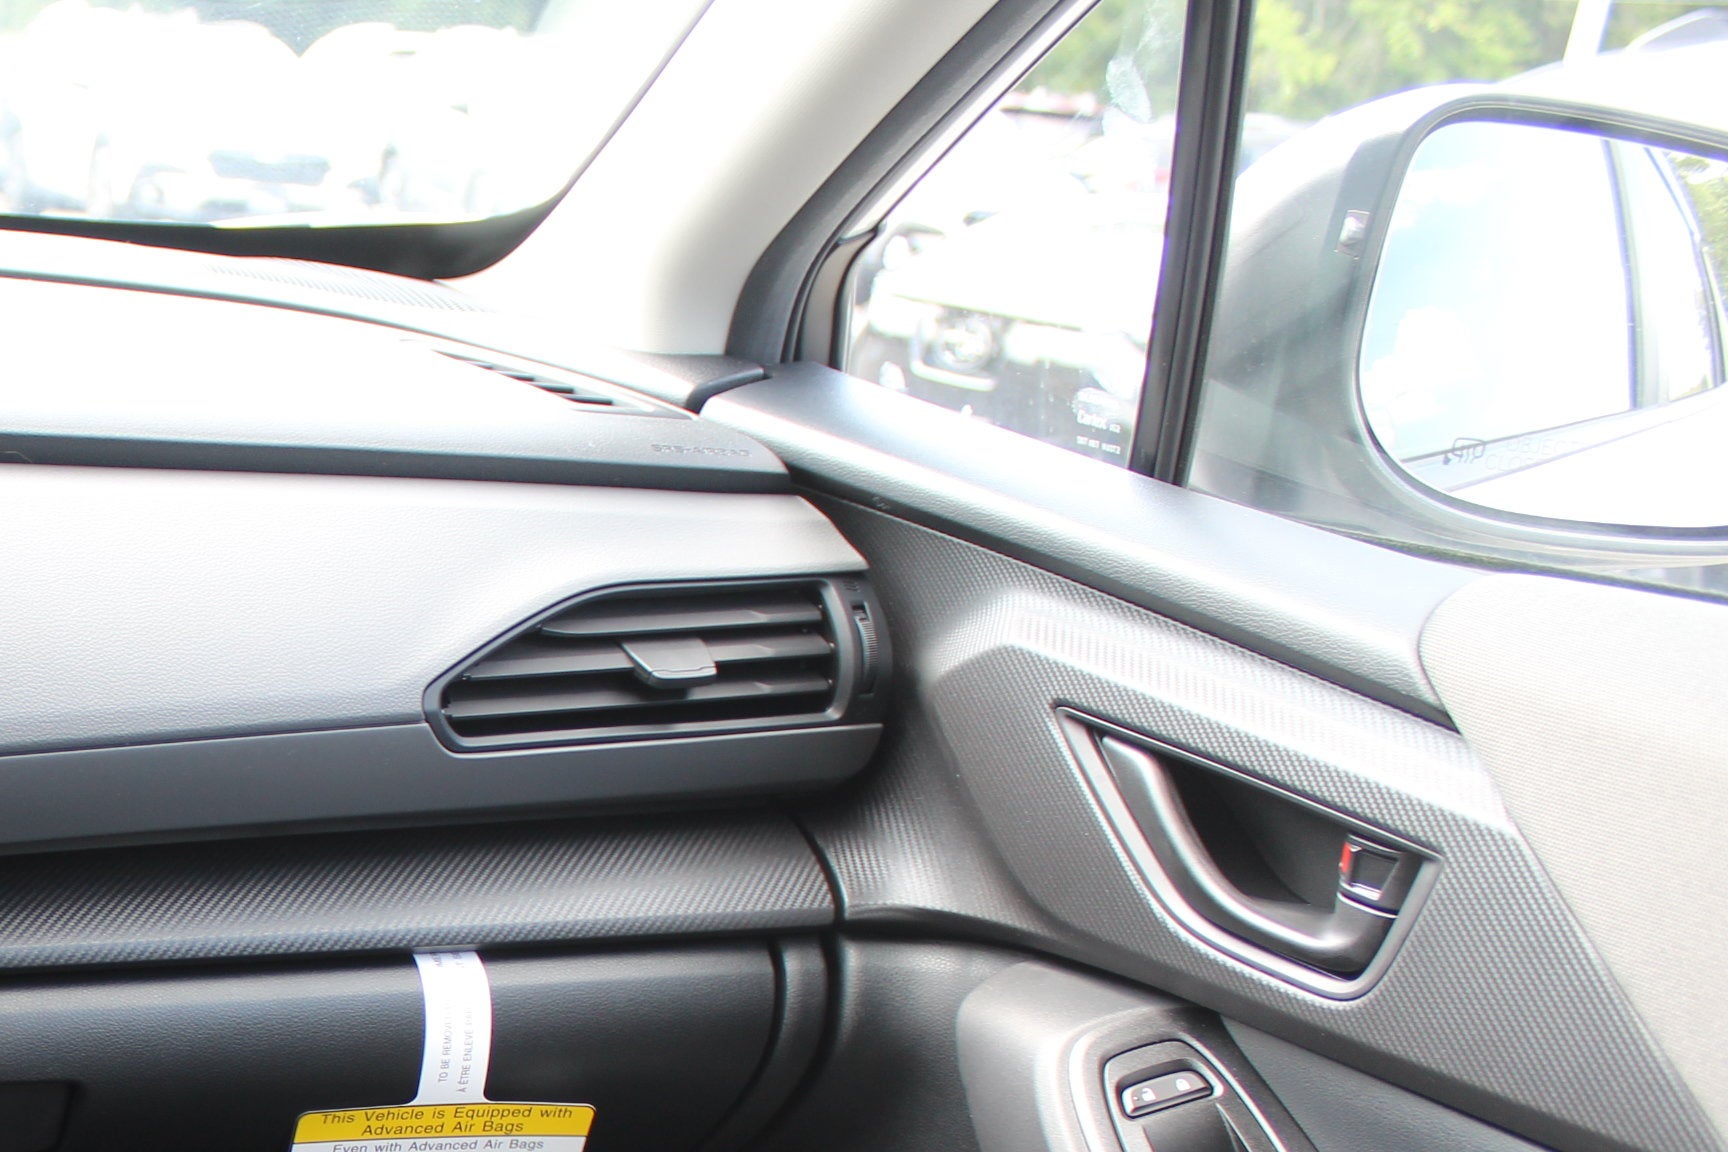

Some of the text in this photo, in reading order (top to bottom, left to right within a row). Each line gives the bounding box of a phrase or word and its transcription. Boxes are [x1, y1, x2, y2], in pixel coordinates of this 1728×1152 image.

[321, 1106, 573, 1125] This Vehicle is Equipped with
[361, 1120, 524, 1136] Advanced Air Bags
[374, 1142, 402, 1152] with
[408, 1140, 478, 1152] Advanced
[483, 1139, 504, 1150] Air
[508, 1139, 545, 1151] Bags
